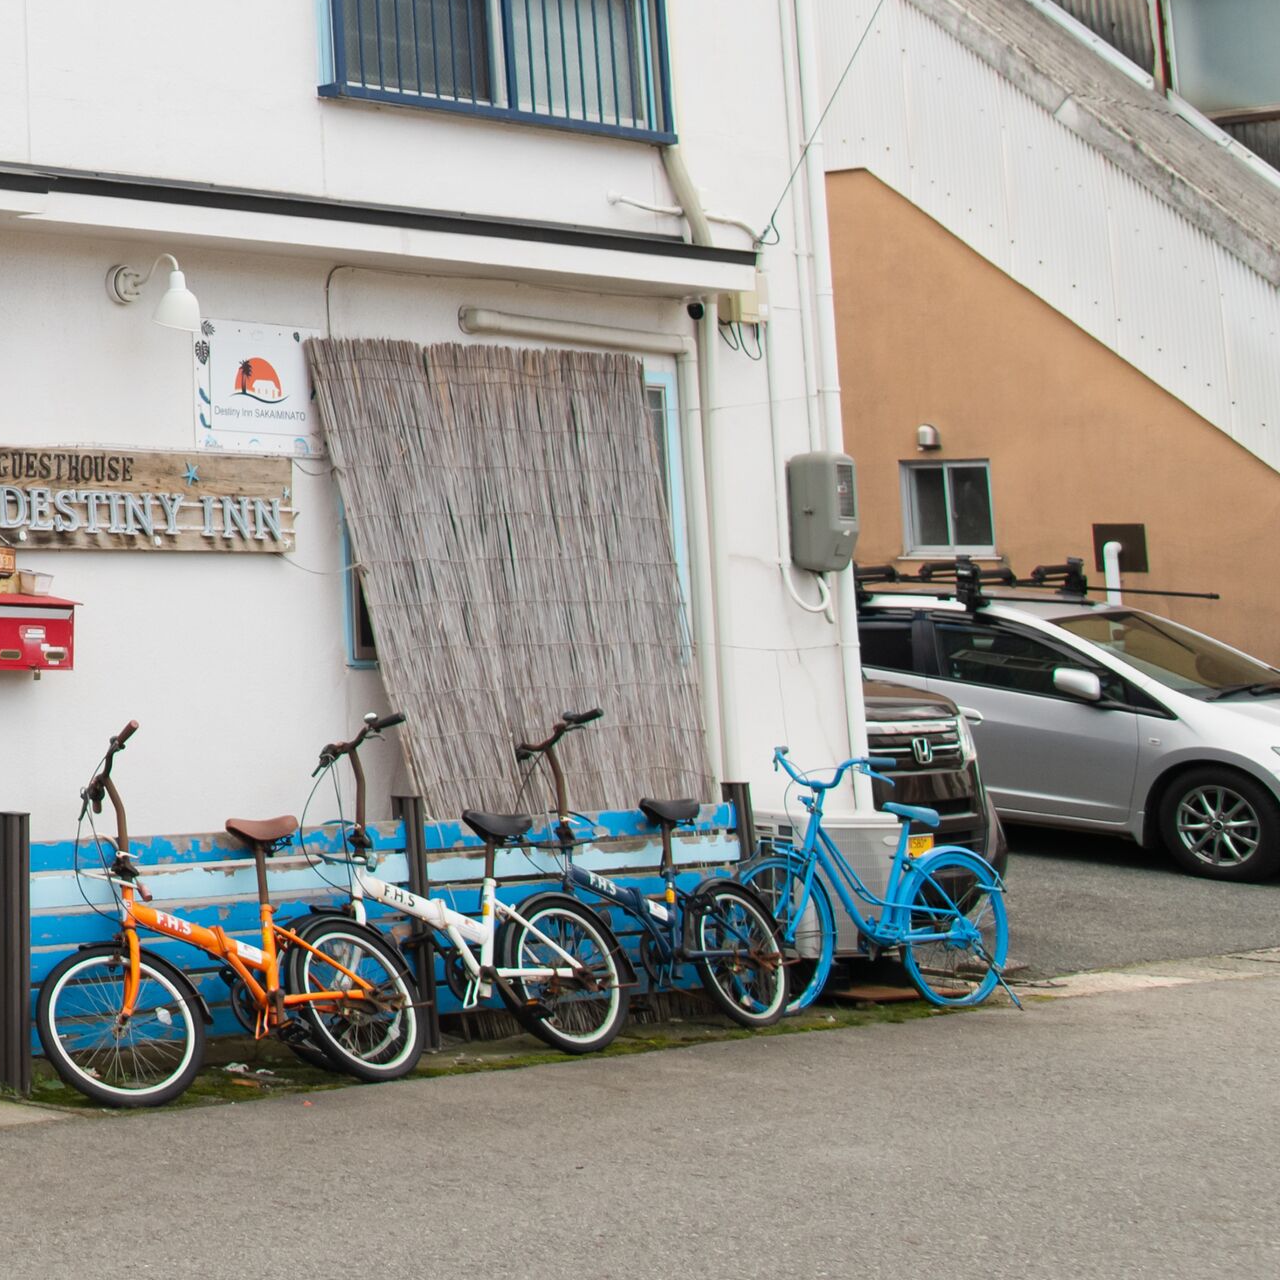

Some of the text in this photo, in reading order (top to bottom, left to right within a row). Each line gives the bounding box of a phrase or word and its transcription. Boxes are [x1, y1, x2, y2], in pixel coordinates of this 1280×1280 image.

[213, 405, 306, 422] Destiny Inn SAKAIMINATO
[200, 495, 283, 541] INN
[383, 884, 416, 908] F.H.S
[588, 870, 617, 896] F.H.S
[155, 909, 192, 936] F.H.S
